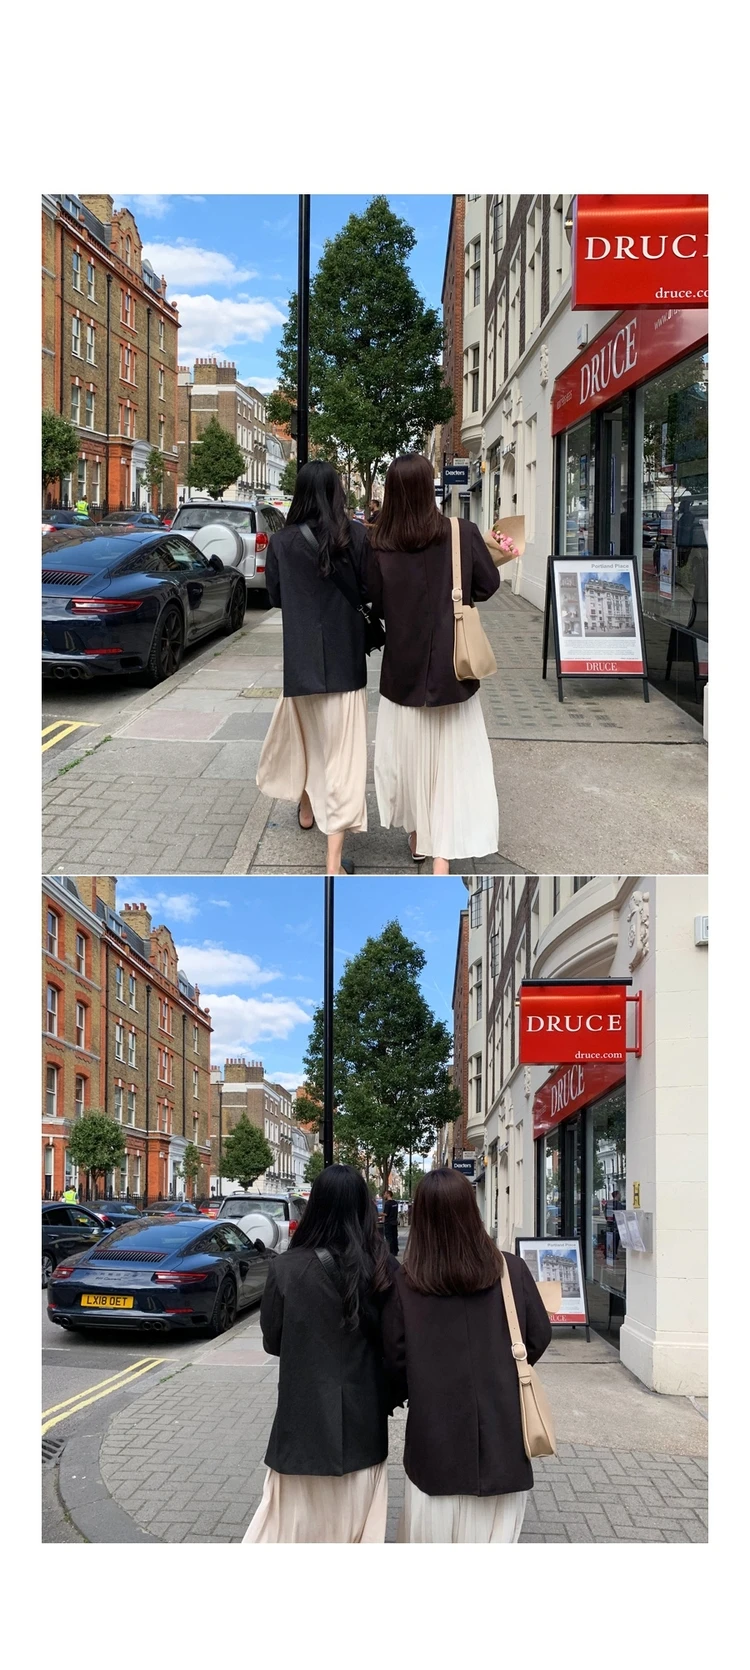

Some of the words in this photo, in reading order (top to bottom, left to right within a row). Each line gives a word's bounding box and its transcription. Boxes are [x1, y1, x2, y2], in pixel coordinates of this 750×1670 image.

[584, 233, 708, 260] DRUC
[579, 317, 638, 405] DRUCE
[586, 662, 618, 671] DRUCE
[526, 1014, 622, 1032] DRUCE
[574, 1050, 623, 1059] druce.com
[550, 1064, 586, 1117] DRUCE
[86, 1295, 107, 1306] LX18
[109, 1296, 128, 1306] OET
